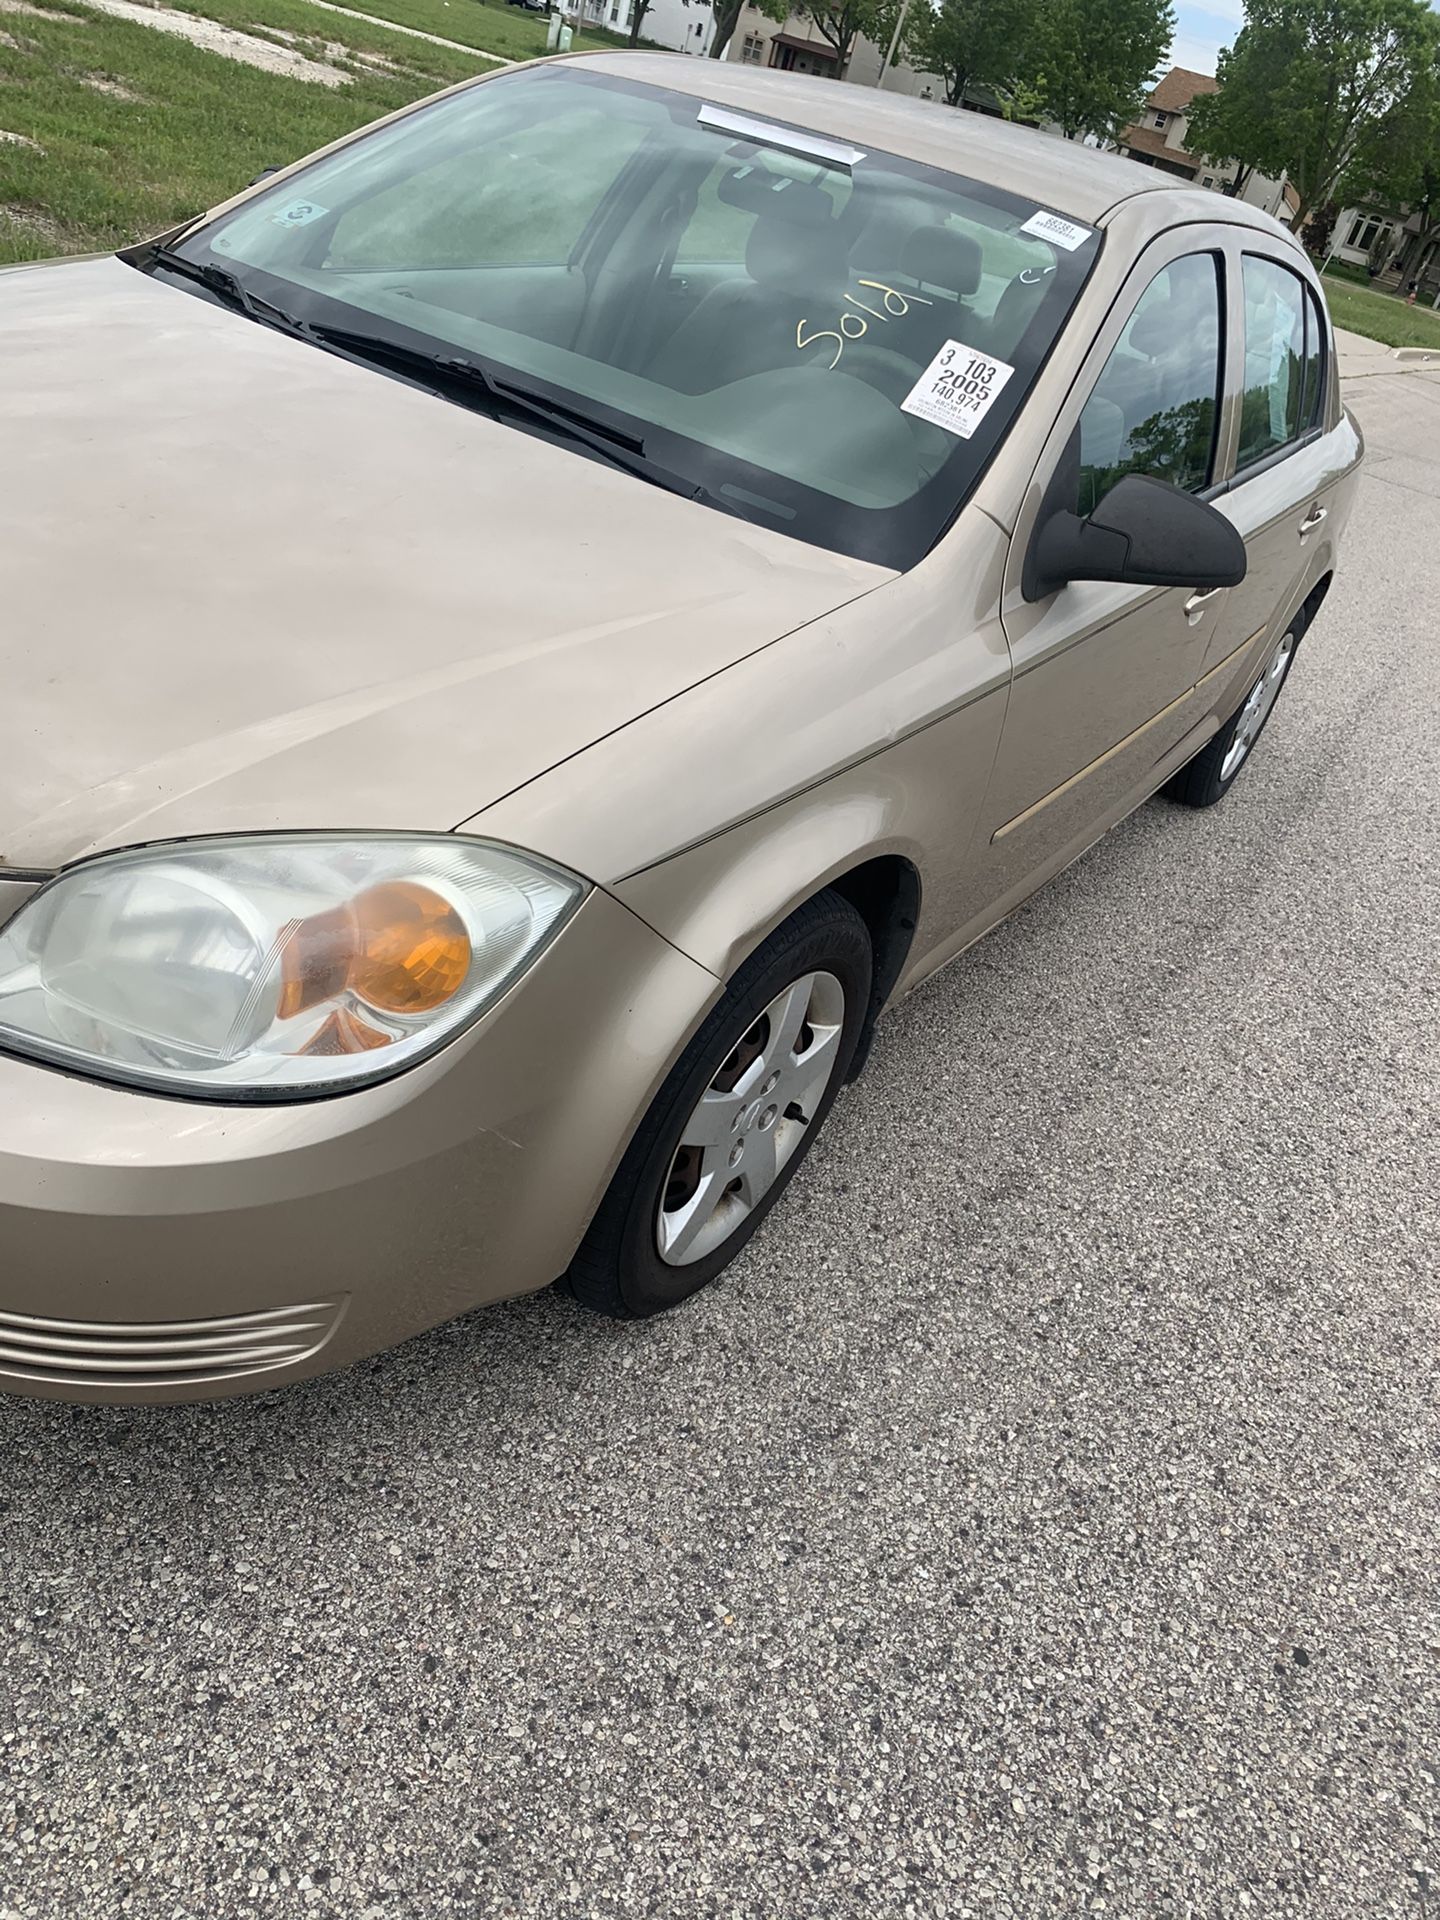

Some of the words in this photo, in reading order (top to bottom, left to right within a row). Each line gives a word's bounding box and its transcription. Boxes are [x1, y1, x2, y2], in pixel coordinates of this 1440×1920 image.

[796, 279, 933, 370] Sold
[940, 348, 956, 366] 3
[964, 359, 997, 384] 103
[931, 382, 981, 412] 140,974
[938, 369, 992, 402] 2005
